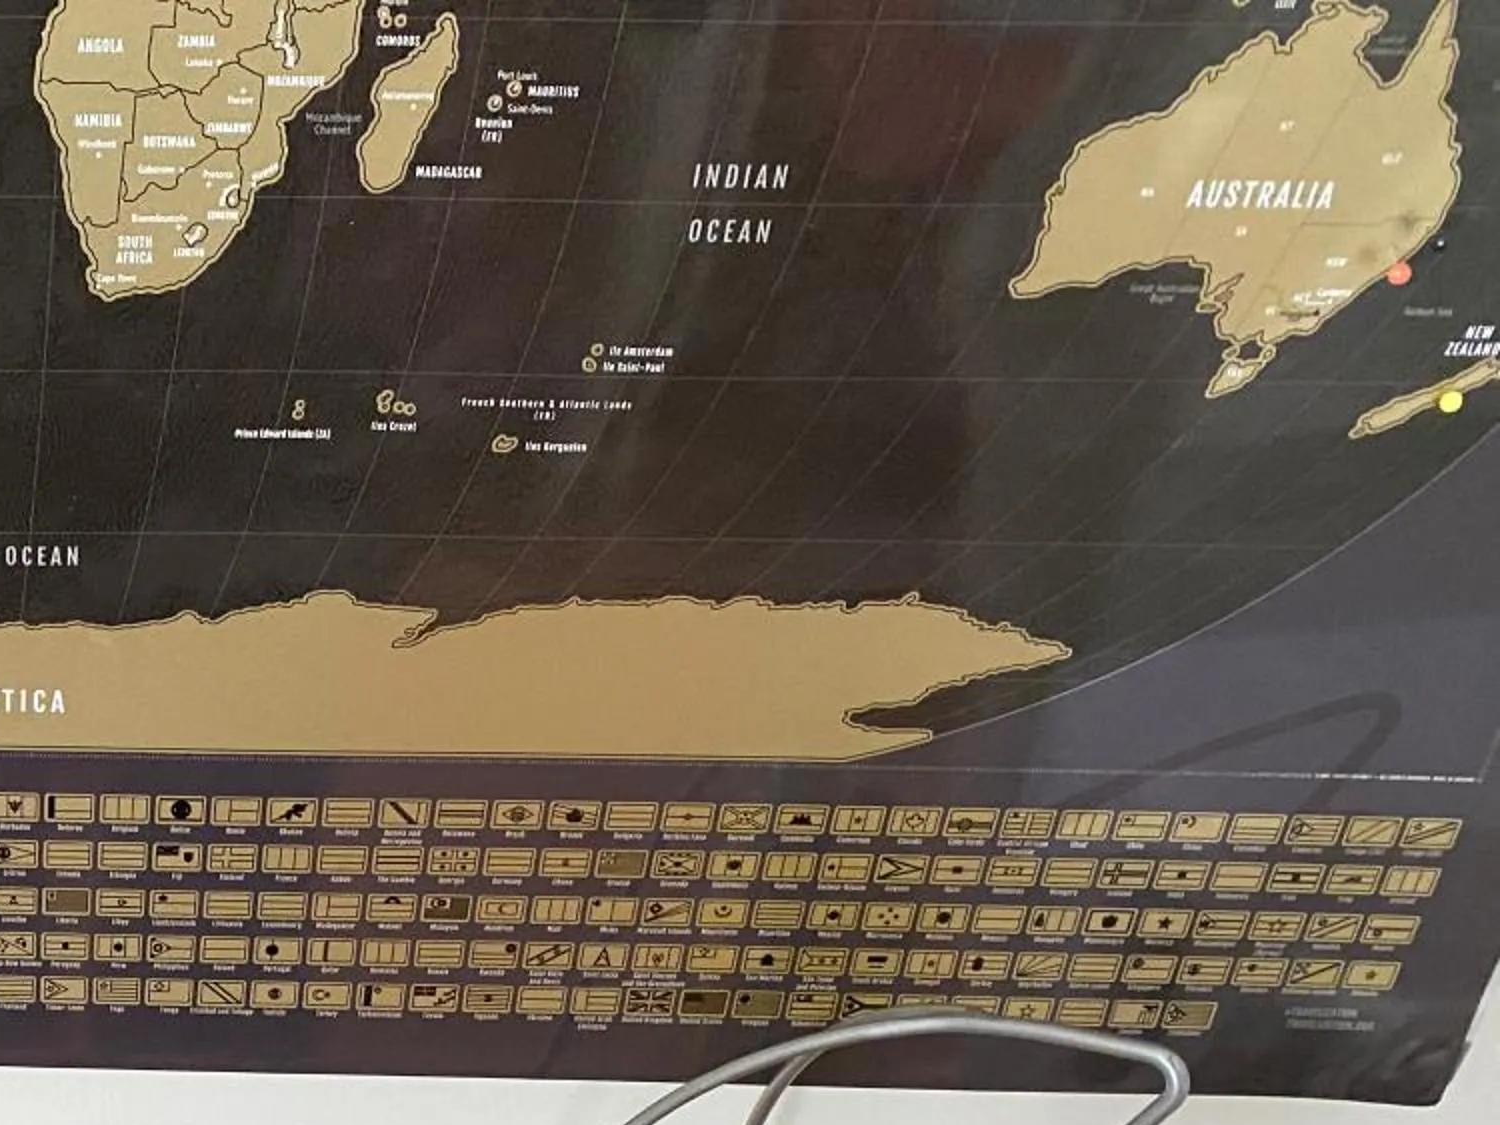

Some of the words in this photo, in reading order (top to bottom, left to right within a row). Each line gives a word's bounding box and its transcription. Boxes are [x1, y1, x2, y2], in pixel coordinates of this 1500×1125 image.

[78, 38, 124, 53] ANGOLA
[177, 35, 216, 48] ZAMBIA
[75, 113, 123, 129] NAMIBIA
[415, 165, 483, 179] MADAGASCAR
[692, 163, 790, 190] INDIAN
[1186, 180, 1335, 210] AUSTRALIA
[687, 218, 774, 245] OCEAN
[117, 235, 153, 249] SOUTH
[115, 250, 153, 265] AFRICA
[1465, 325, 1496, 341] NEW
[4, 544, 82, 569] OCEAN
